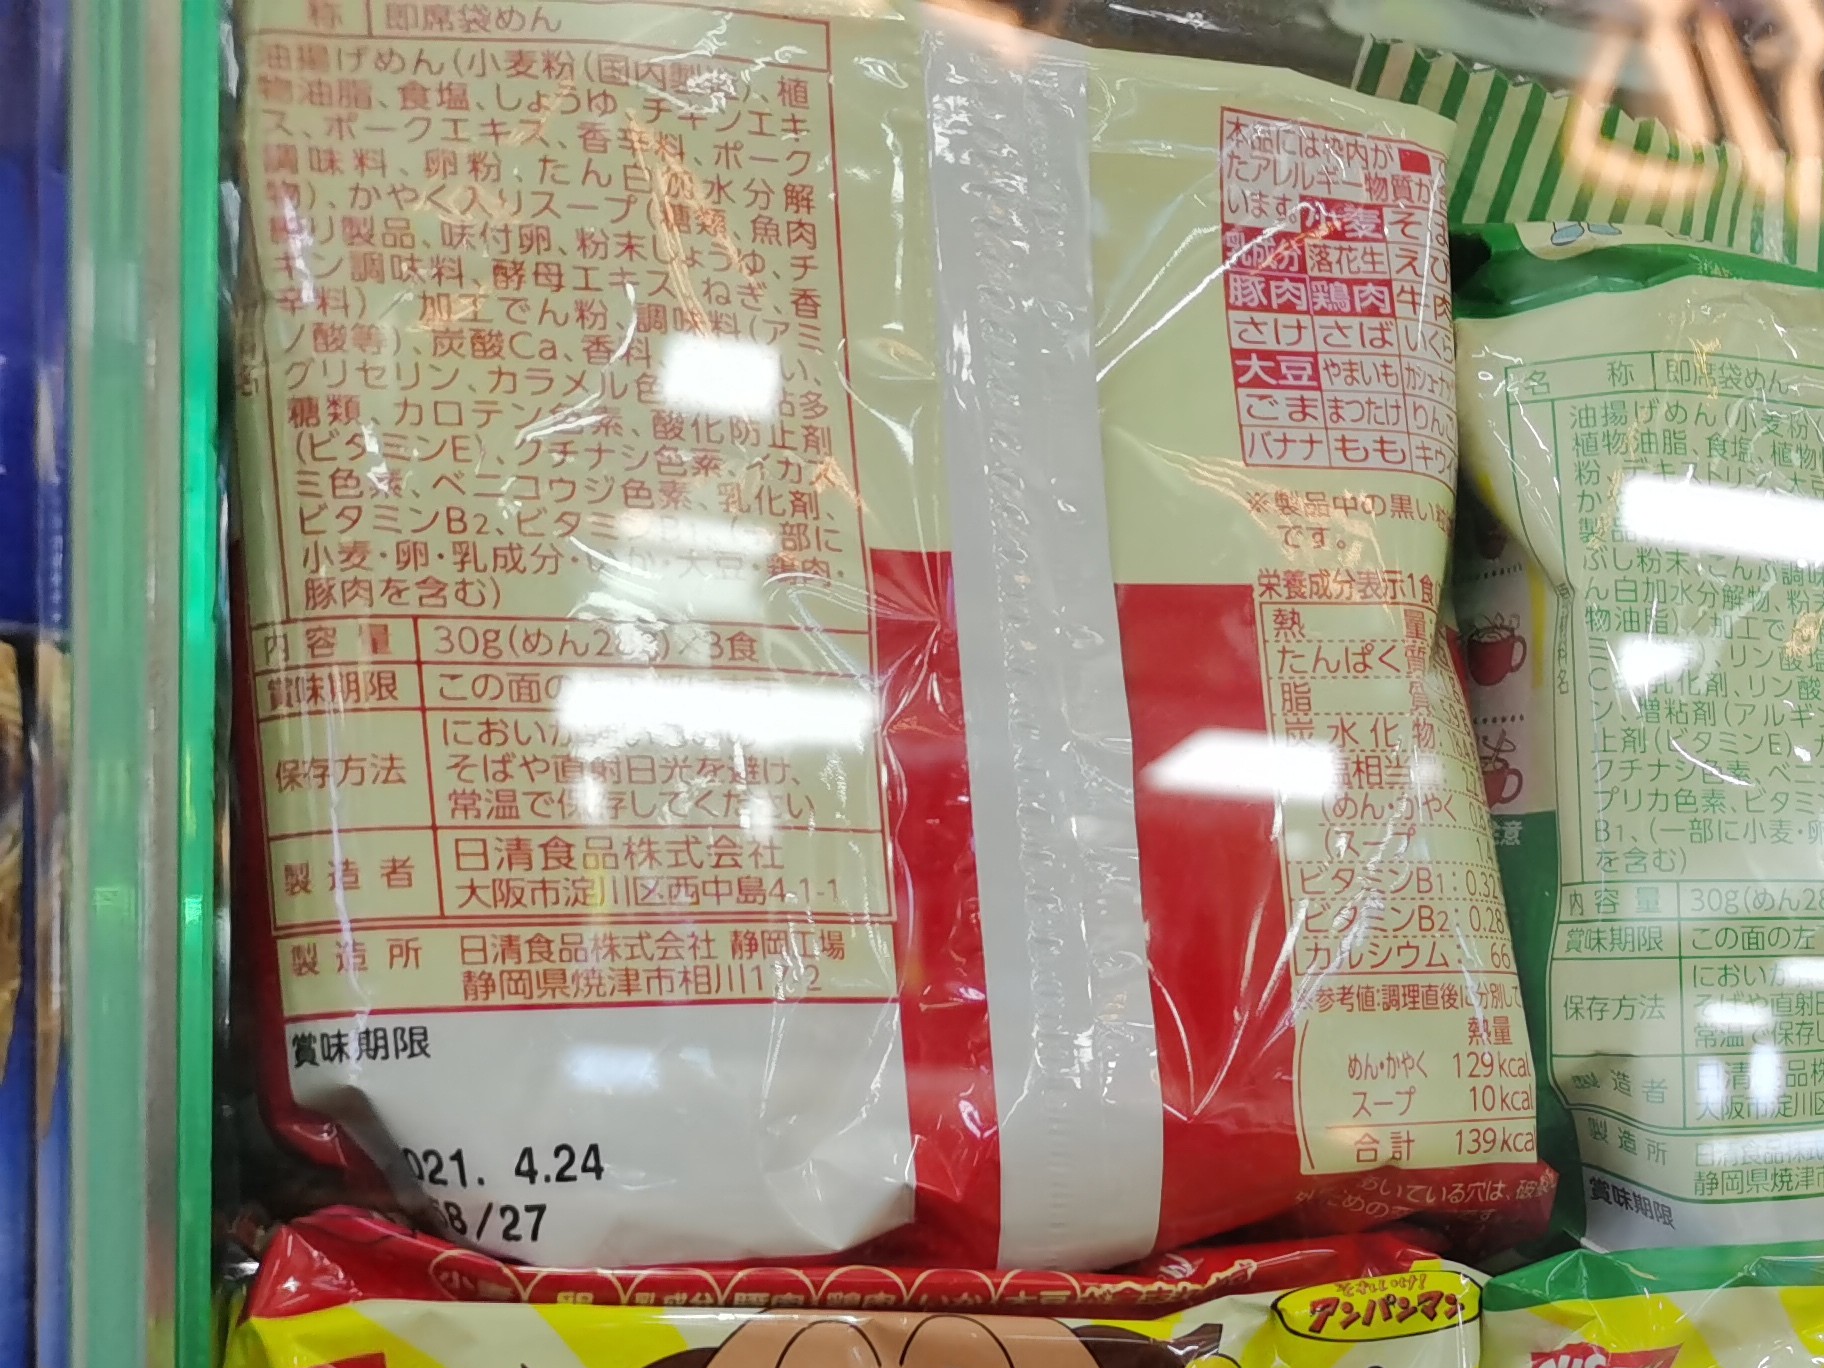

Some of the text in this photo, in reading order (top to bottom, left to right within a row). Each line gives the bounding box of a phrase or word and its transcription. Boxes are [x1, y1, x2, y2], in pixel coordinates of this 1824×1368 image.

[384, 3, 563, 35] 即席袋めん
[1308, 243, 1387, 276] 落花生
[1229, 277, 1309, 312] 豚肉
[1310, 280, 1392, 316] 鶏肉
[1235, 318, 1310, 348] さけ
[1318, 319, 1395, 350] さば
[1236, 357, 1318, 387] 大豆
[1322, 359, 1399, 390] やまいも
[1245, 392, 1321, 423] ごま
[1327, 397, 1401, 427] まつたけ
[1248, 431, 1324, 462] バナナ
[1333, 435, 1407, 464] もも
[1276, 524, 1348, 550] です。
[304, 575, 502, 610] 豚肉を含む)
[266, 664, 399, 709] 賞味期限
[275, 753, 408, 790] 保存方法
[454, 834, 785, 874] 日清食品株式会社
[1596, 846, 1688, 875] を含む)
[459, 932, 716, 967] 日清食品株式会社
[729, 928, 846, 962] 静岡工場
[1564, 926, 1664, 954] 賞味期限
[1562, 995, 1667, 1022] 保存方法
[291, 1026, 431, 1069] 賞味期限
[1468, 1016, 1513, 1046] 熱量
[1347, 1051, 1428, 1080] めん・かやく
[1352, 1085, 1416, 1118] スープ
[514, 1142, 605, 1186] 4.24
[1588, 1175, 1677, 1231] 賞味期限
[1308, 1290, 1466, 1335] アンパンマン
